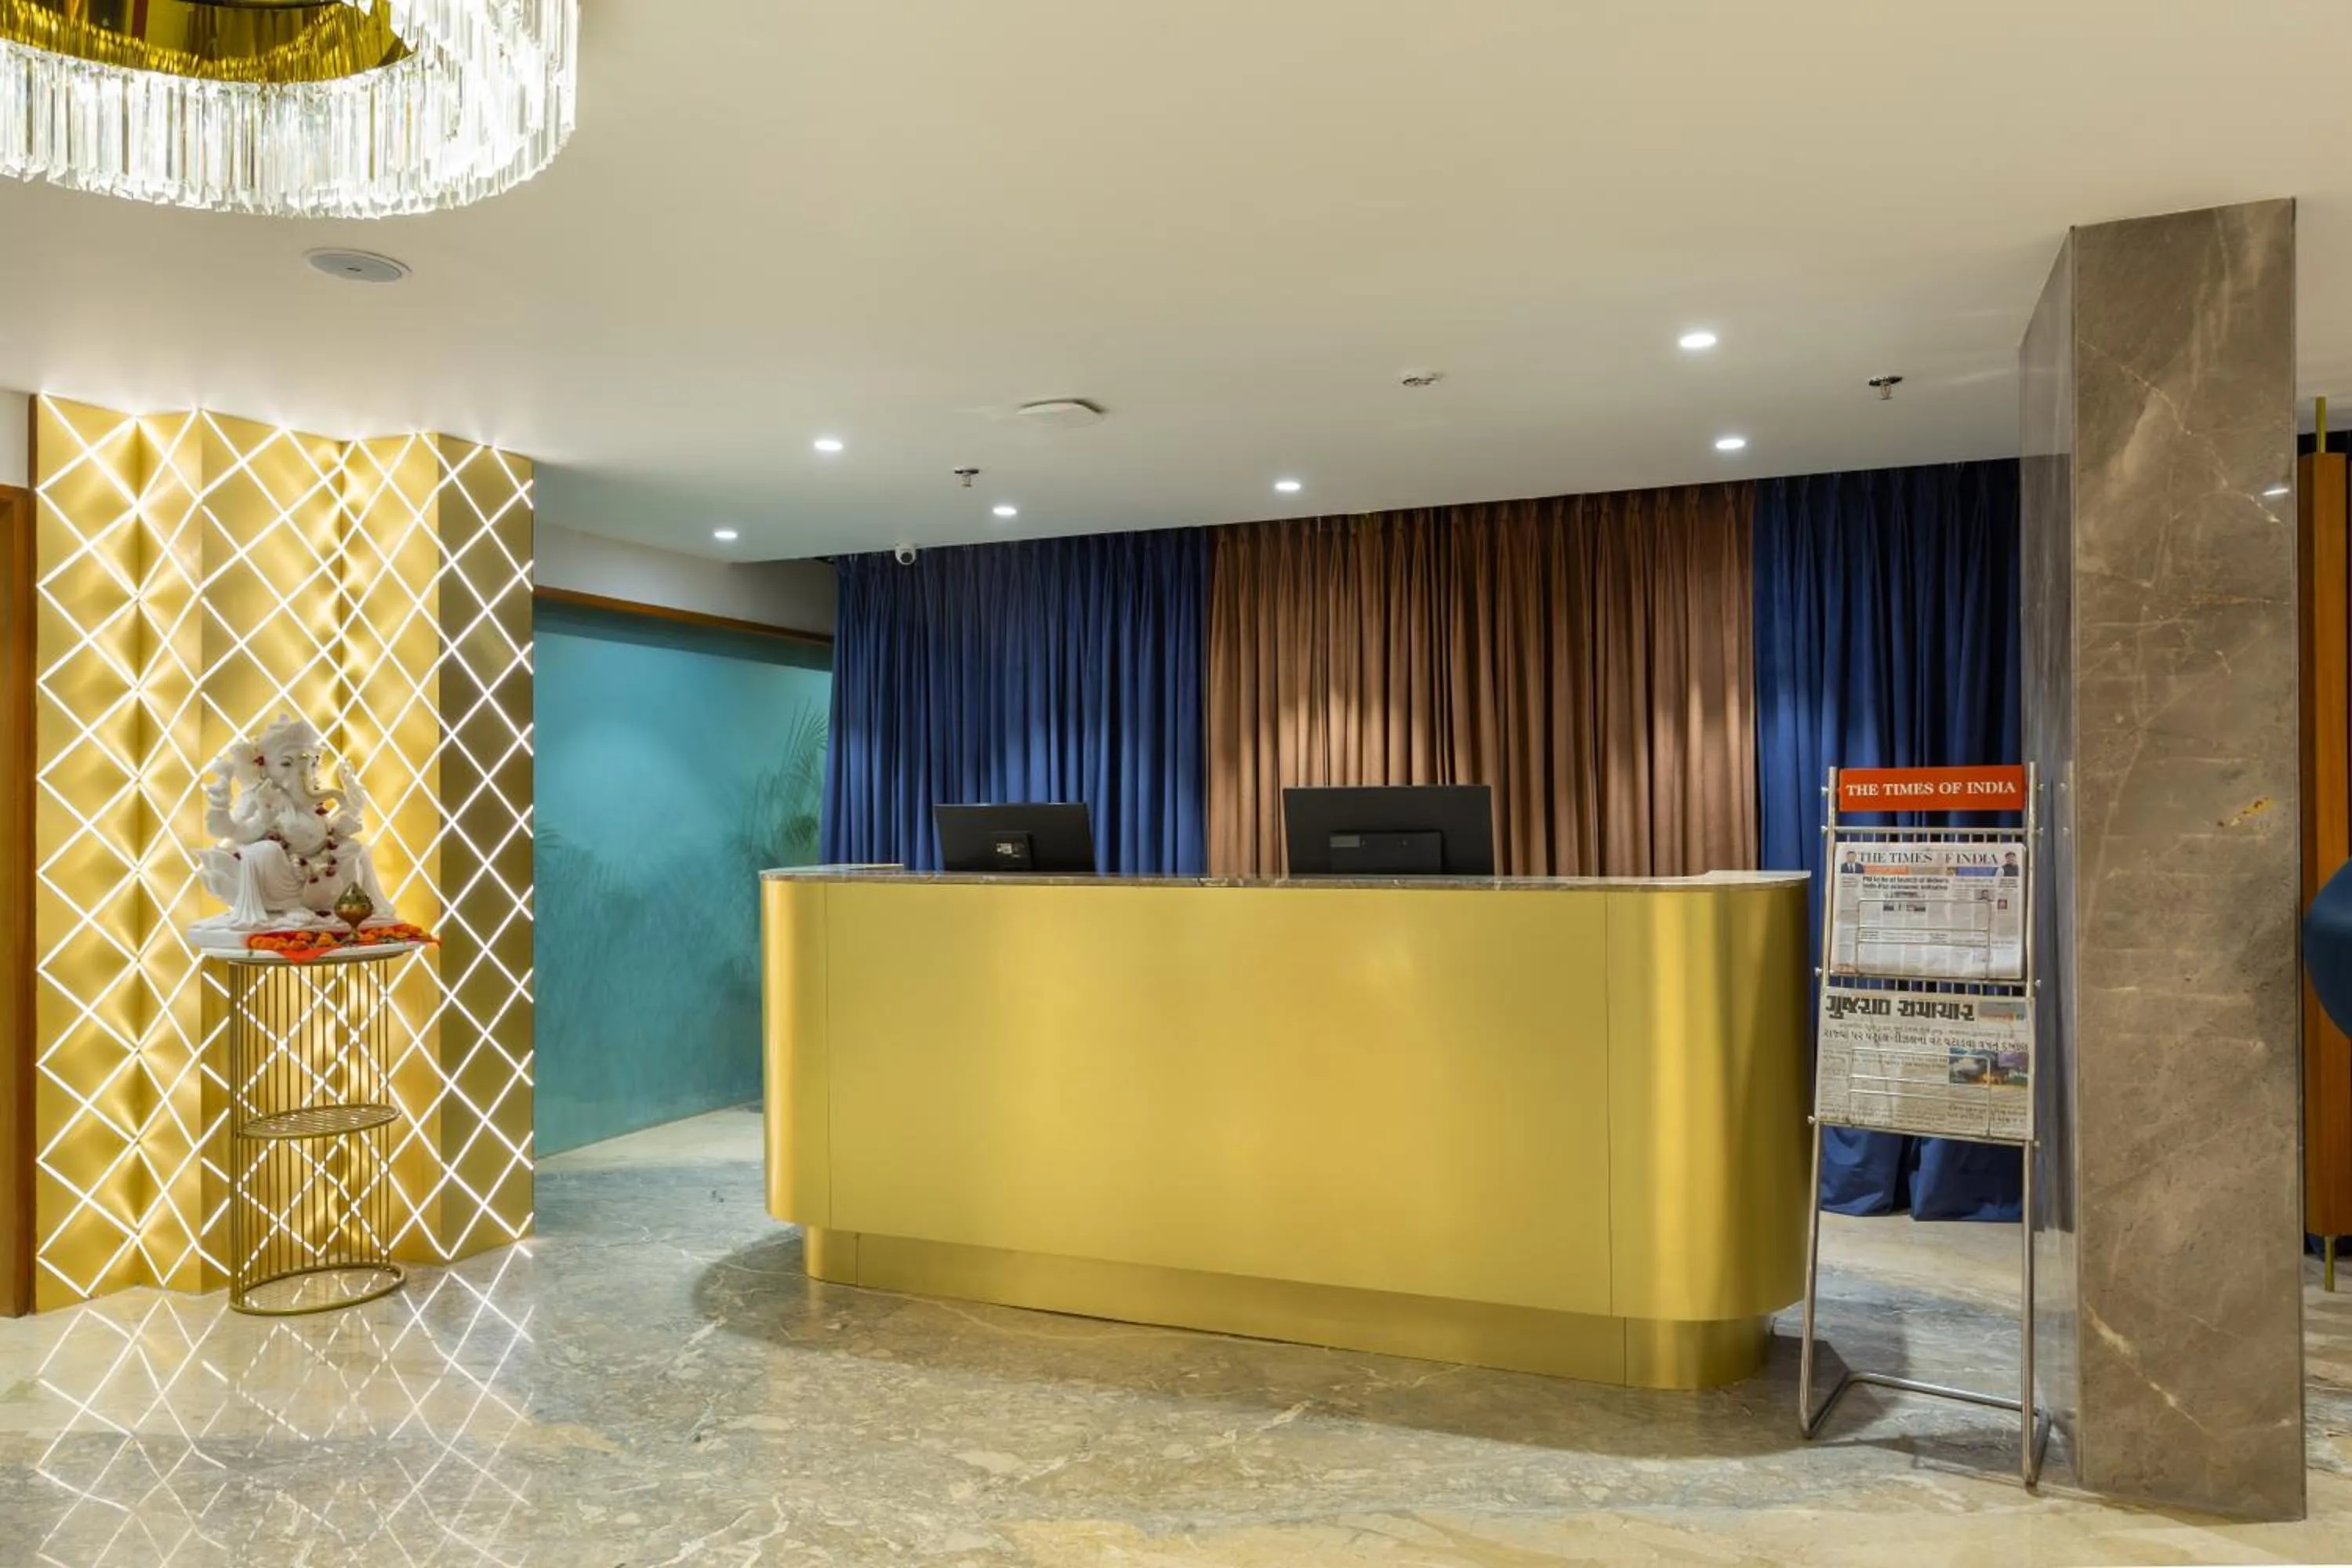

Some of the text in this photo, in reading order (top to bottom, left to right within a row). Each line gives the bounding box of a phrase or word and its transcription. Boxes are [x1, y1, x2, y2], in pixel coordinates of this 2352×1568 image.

[1845, 781, 2016, 797] THE TIMES OF INDIA
[1859, 852, 1887, 863] THE
[1888, 852, 1933, 864] TIMES
[1956, 853, 1998, 865] INDIA
[1826, 995, 1975, 1022] ગુજરાત સમાચાર
